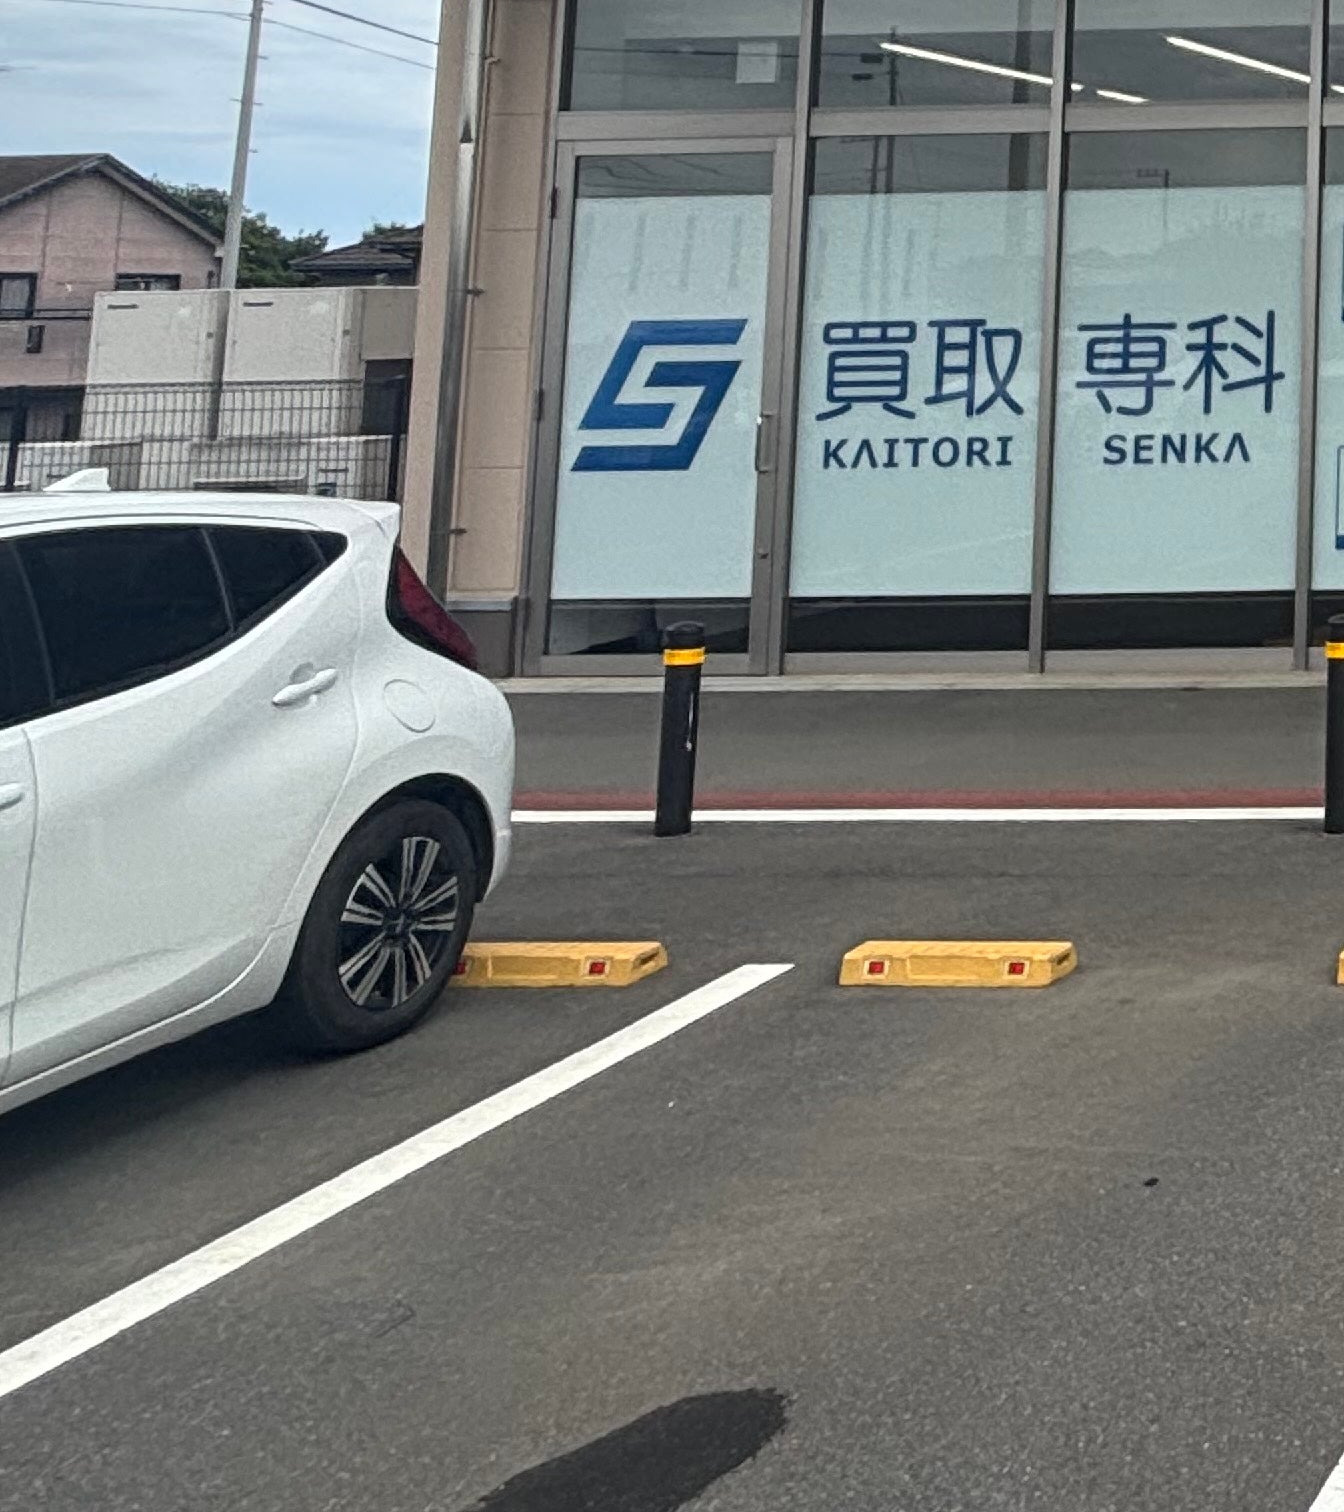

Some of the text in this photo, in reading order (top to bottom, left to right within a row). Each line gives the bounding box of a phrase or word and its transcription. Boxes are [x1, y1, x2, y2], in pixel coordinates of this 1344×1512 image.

[815, 309, 1286, 420] 買取専科
[822, 432, 1251, 470] KAITORI SENKA
